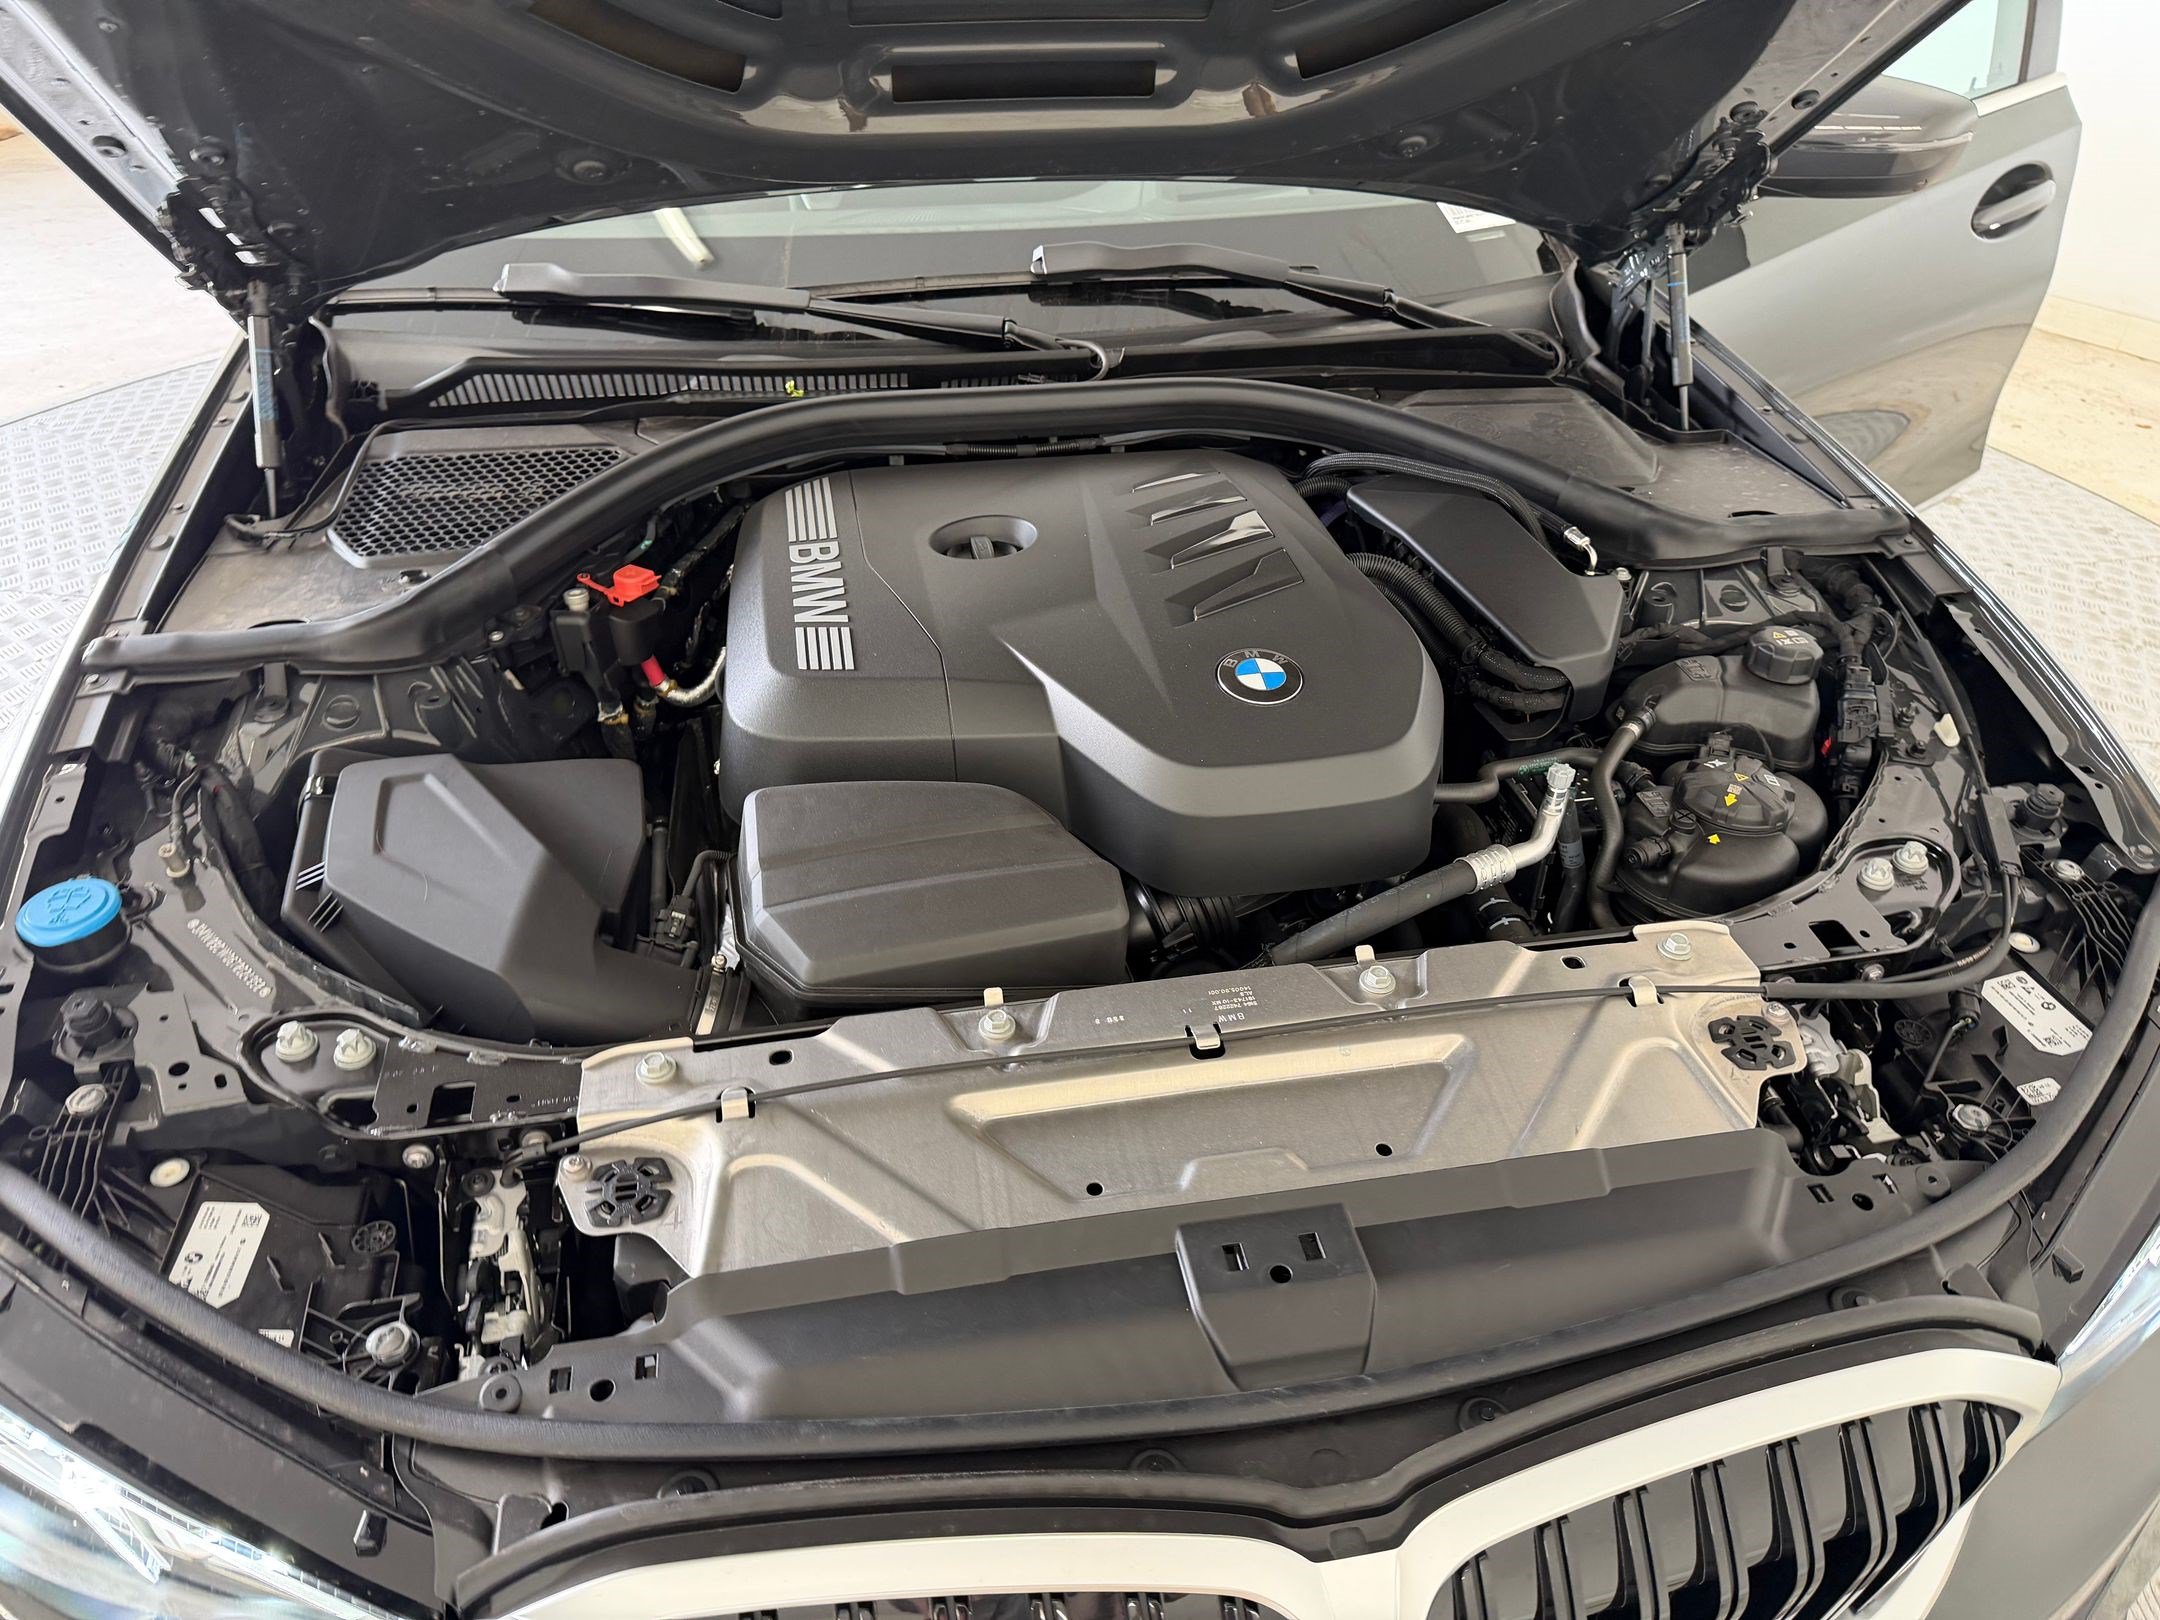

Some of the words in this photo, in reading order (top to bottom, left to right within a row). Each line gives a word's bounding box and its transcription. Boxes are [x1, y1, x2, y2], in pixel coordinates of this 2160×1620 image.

[789, 541, 849, 623] BMW
[1223, 649, 1288, 668] BMW
[1218, 1012, 1245, 1022] BMW
